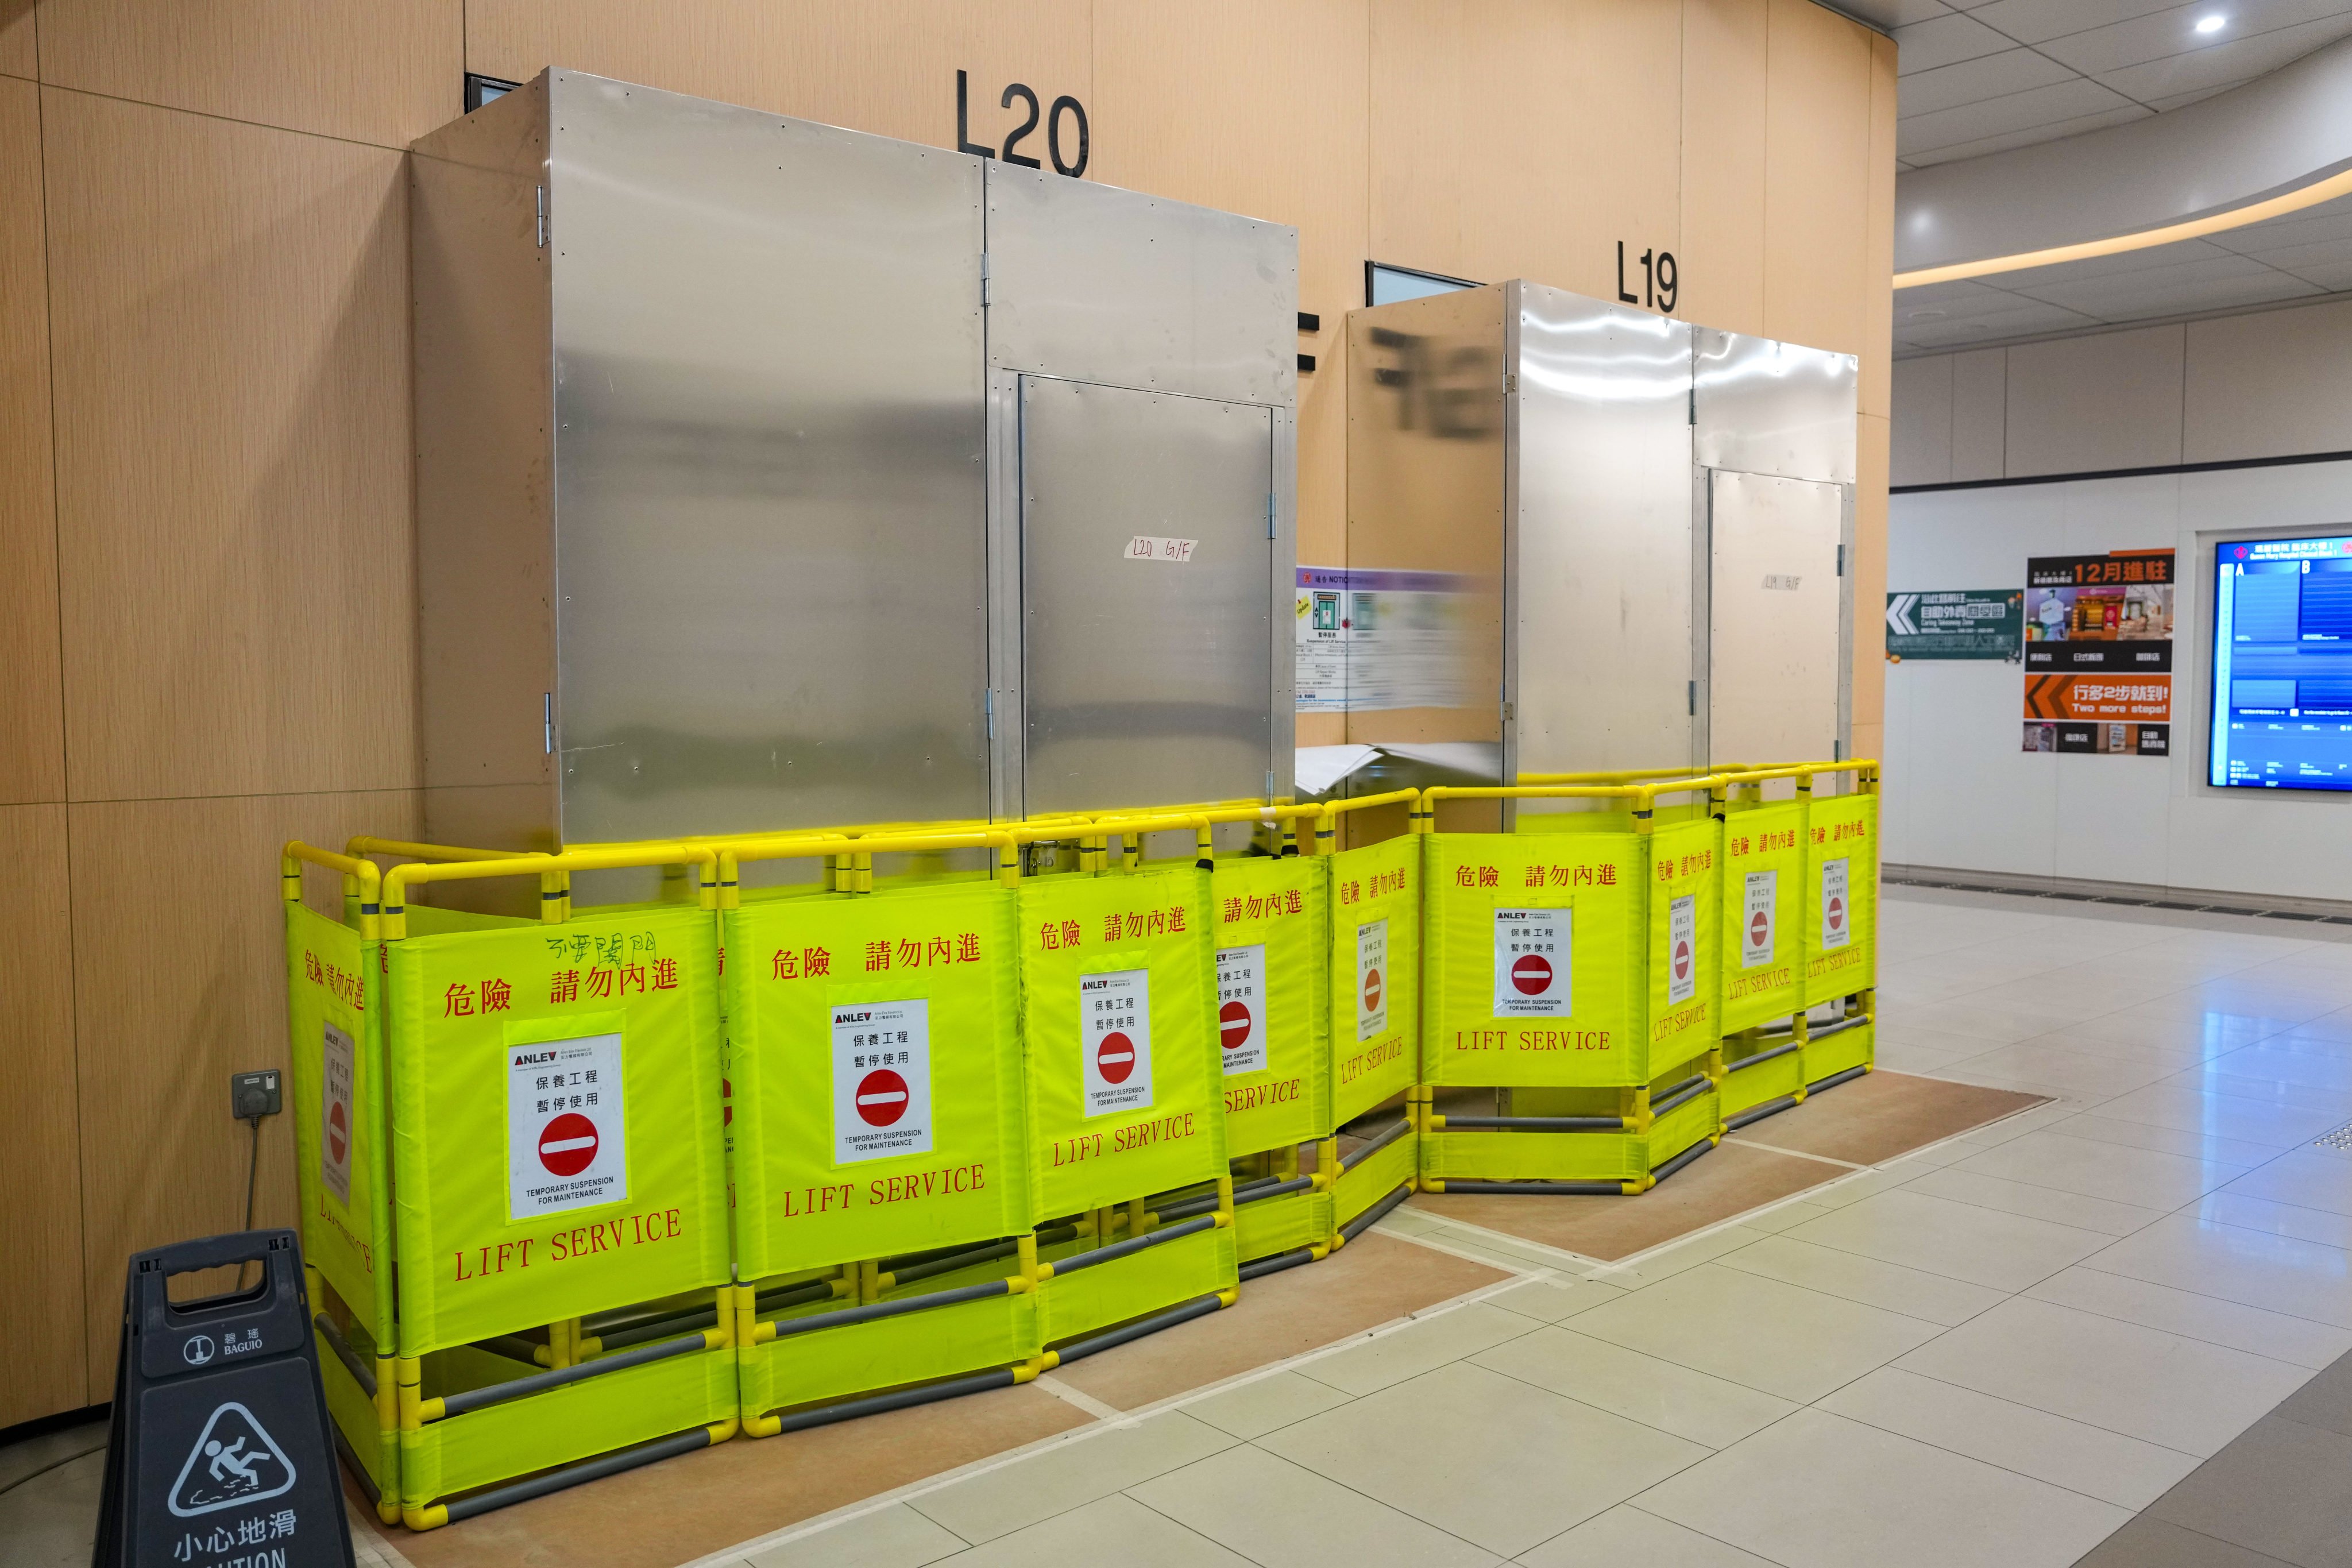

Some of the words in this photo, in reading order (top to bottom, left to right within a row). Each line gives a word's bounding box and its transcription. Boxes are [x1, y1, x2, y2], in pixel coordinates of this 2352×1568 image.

[957, 69, 1089, 179] L20
[1617, 240, 1678, 313] L19
[1133, 539, 1152, 557] L20
[1165, 540, 1189, 561] G/F
[2075, 560, 2166, 582] 12月進駐
[2235, 563, 2244, 576] A
[2302, 560, 2310, 574] B
[1329, 576, 1348, 584] NOTIC
[2073, 685, 2168, 701] 行多2步就到!
[2072, 702, 2095, 713] Two
[2099, 705, 2126, 713] more
[2131, 704, 2166, 715] steps!
[1731, 836, 1749, 856] 危險
[1759, 829, 1794, 852] 請勿內進
[1657, 859, 1673, 882] 危險
[1681, 849, 1712, 877] 請勿內進
[1456, 864, 1499, 888] 危險
[1525, 864, 1617, 887] 請勿內進
[1341, 881, 1360, 905] 危險
[1370, 867, 1405, 899] 請勿內進
[1224, 890, 1302, 923] 請勿內進
[1040, 919, 1081, 950] 危險
[1104, 906, 1186, 943] 請勿內進
[1511, 928, 1554, 937] 保養工程
[772, 946, 831, 980] 危險
[866, 933, 981, 972] 請勿內進
[1511, 944, 1554, 952] 暫停使用
[444, 978, 512, 1018] 危險
[550, 957, 678, 1005] 請勿內進
[1082, 980, 1107, 990] ANLEV
[1095, 998, 1134, 1011] 保養工程
[835, 1012, 871, 1024] ANLEV
[1096, 1016, 1134, 1030] 暫停使用
[853, 1031, 908, 1048] 保養工程
[1457, 1031, 1508, 1051] LIFT
[1519, 1031, 1610, 1051] SERVICE
[515, 1051, 557, 1065] ANLEV
[854, 1052, 908, 1068] 暫停使用
[1234, 1049, 1260, 1059] SUSPENSION
[1342, 1055, 1363, 1084] LIFT
[1367, 1036, 1402, 1071] SERVICE
[1223, 1058, 1253, 1068] MAINTENANCE
[536, 1070, 597, 1090] 保養工程
[1091, 1090, 1117, 1099] TEMPORARY
[1117, 1086, 1145, 1095] SUSPENSION
[1107, 1095, 1138, 1105] MAINTENANCE
[1225, 1079, 1300, 1114] SERVICE
[536, 1092, 598, 1113] 暫停使用
[845, 1133, 882, 1144] TEMPORARY
[883, 1129, 922, 1140] SUSPENSION
[1054, 1133, 1103, 1167] LIFT
[1114, 1112, 1195, 1153] SERVICE
[855, 1144, 868, 1152] FOR
[869, 1139, 912, 1150] MAINTENANCE
[527, 1184, 569, 1197] TEMPORARY
[570, 1176, 613, 1189] SUSPENSION
[785, 1184, 855, 1217] LIFT
[870, 1164, 985, 1205] SERVICE
[538, 1196, 553, 1205] FOR
[554, 1188, 603, 1202] MAINTENANCE
[455, 1238, 534, 1281] LIFT
[551, 1208, 681, 1261] SERVICE
[225, 1328, 259, 1344] 碧瑤
[224, 1339, 262, 1355] BAGUIO
[174, 1509, 296, 1562] 小心地滑
